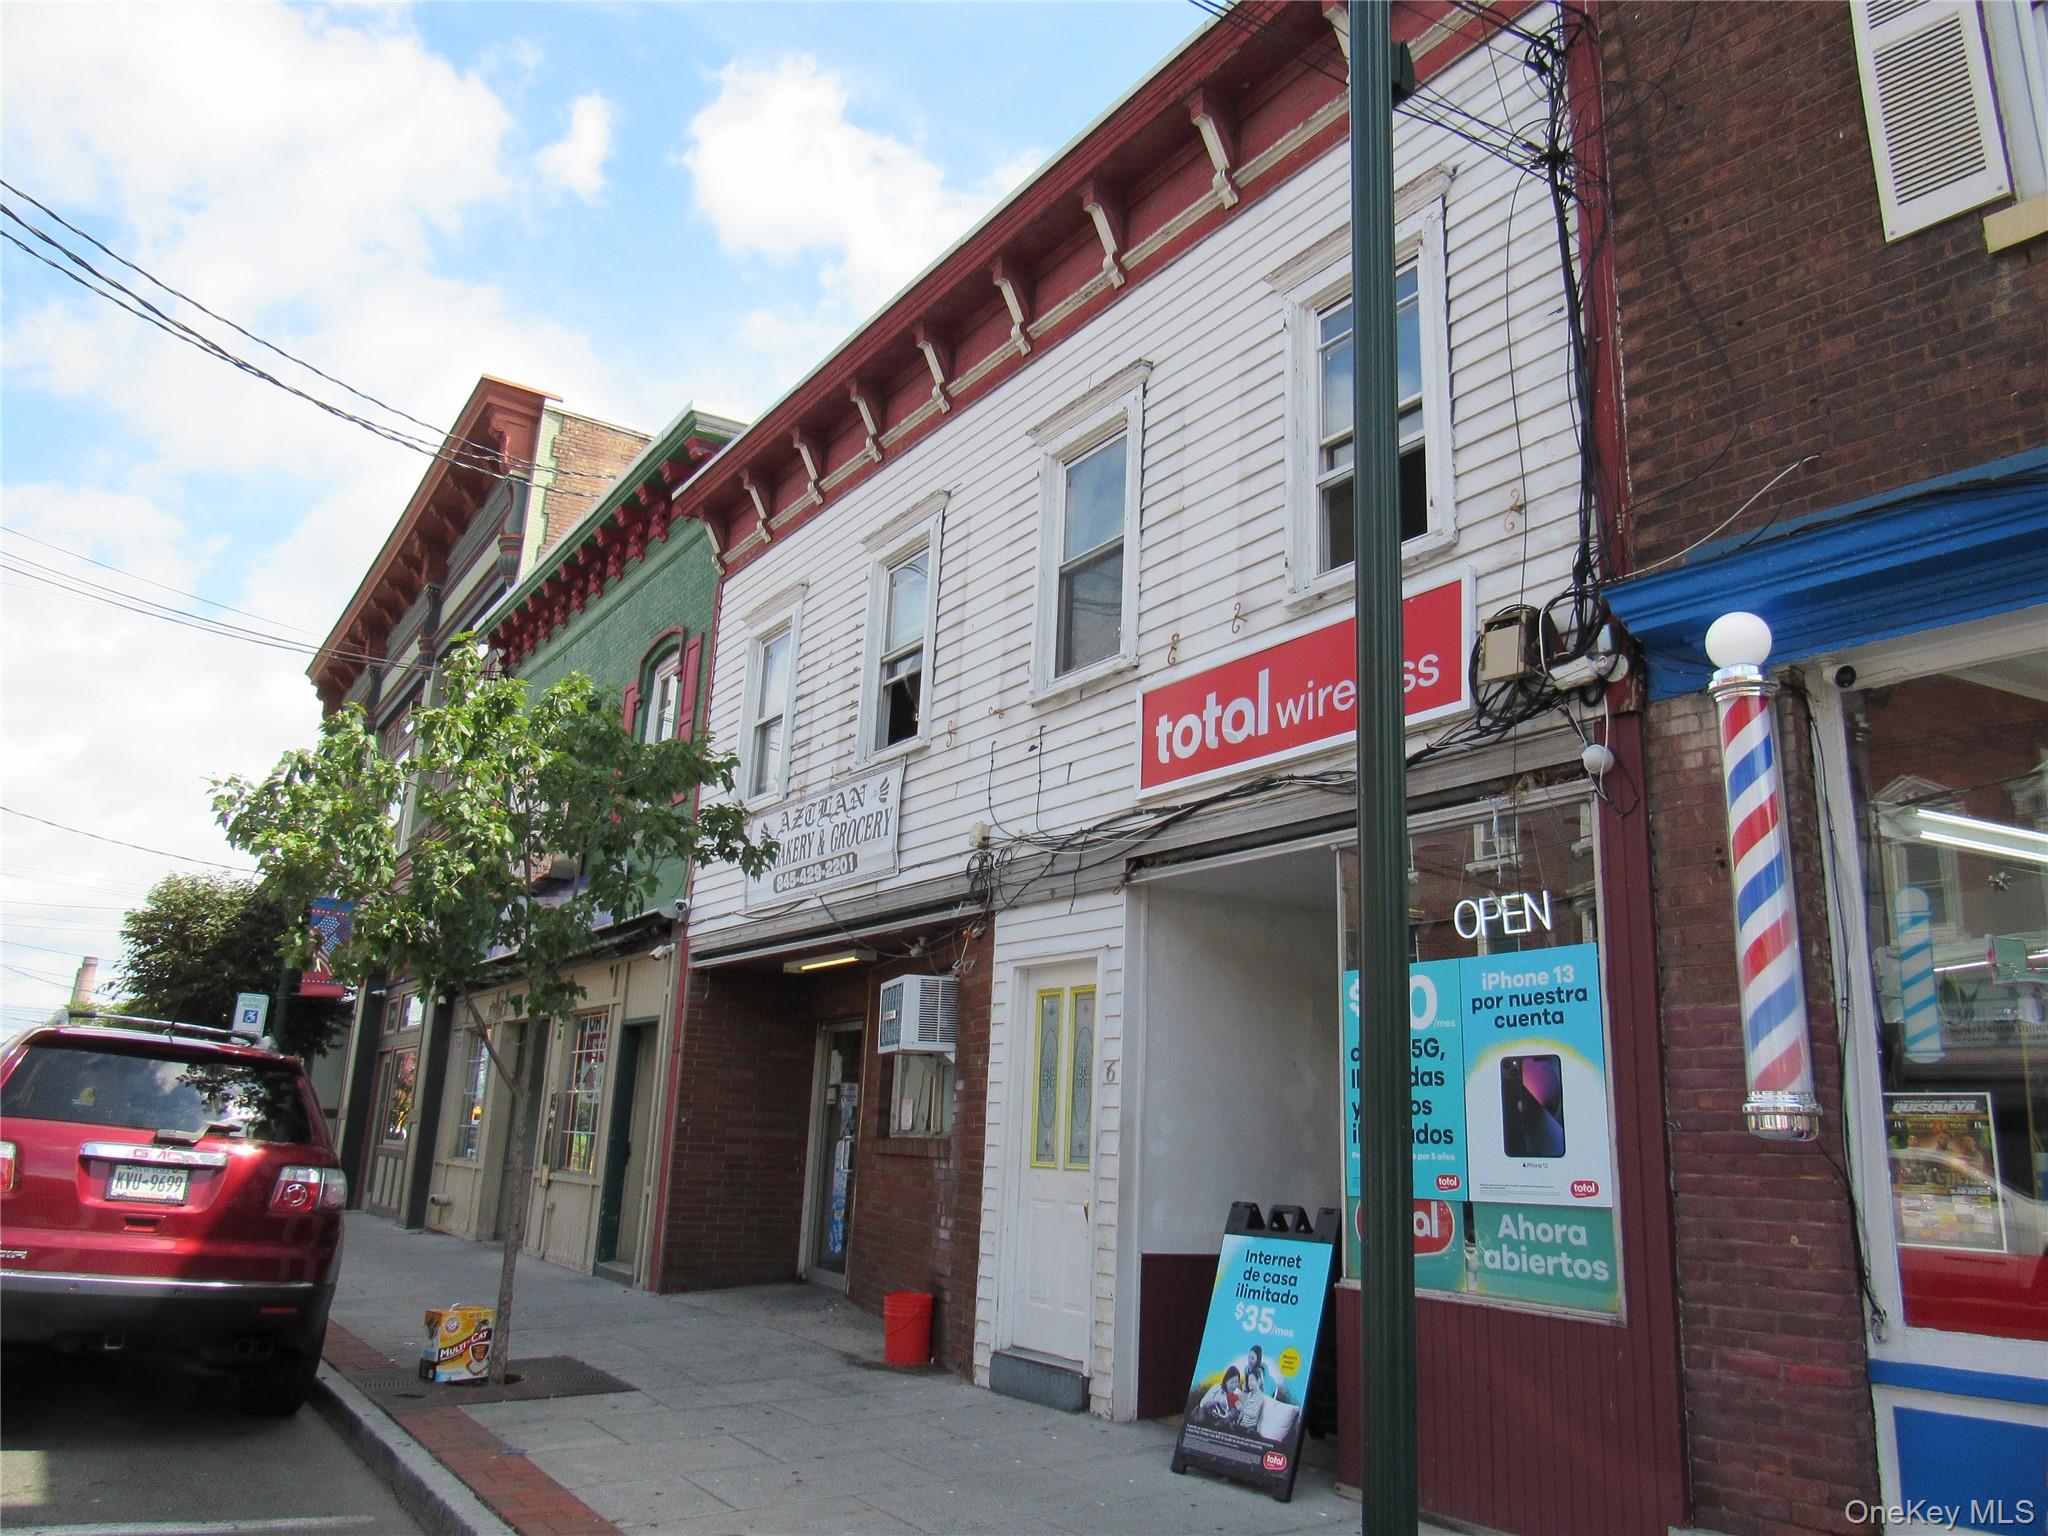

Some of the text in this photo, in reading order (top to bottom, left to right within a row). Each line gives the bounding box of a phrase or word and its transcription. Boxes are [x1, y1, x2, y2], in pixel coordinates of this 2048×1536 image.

[1156, 654, 1440, 764] total wiress
[776, 783, 868, 838] AZTLAN
[818, 829, 826, 855] &
[830, 806, 894, 852] GROCERY
[1453, 889, 1553, 940] OPEN
[1481, 964, 1575, 992] iPhone 13
[1471, 985, 1588, 1015] por nuestra
[1494, 1008, 1565, 1029] cuenta
[1438, 1176, 1457, 1187] total
[1573, 1182, 1596, 1193] total
[1497, 1213, 1588, 1246] Ahora
[1245, 1249, 1302, 1269] Internet
[1484, 1244, 1609, 1281] abiertos
[1243, 1267, 1298, 1287] de casa
[1235, 1282, 1299, 1306] ilimitado
[1266, 1454, 1284, 1466] total
